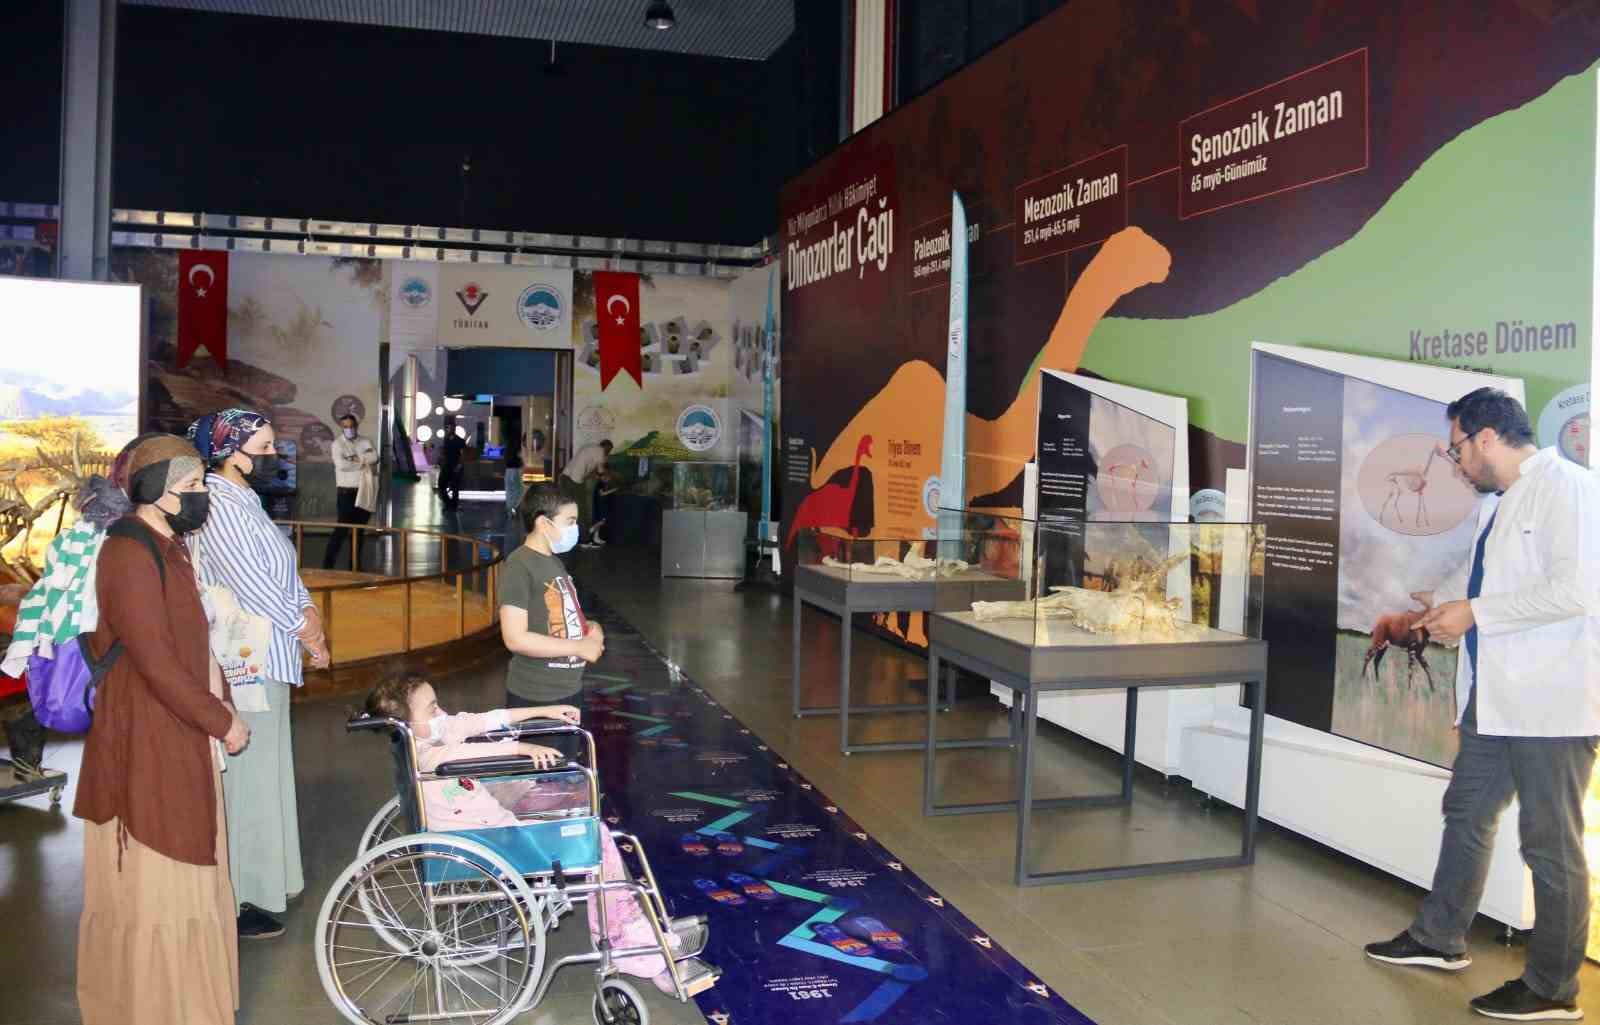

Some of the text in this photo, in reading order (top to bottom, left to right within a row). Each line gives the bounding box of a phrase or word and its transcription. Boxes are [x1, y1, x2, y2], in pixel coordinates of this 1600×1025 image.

[1191, 90, 1343, 167] Senozoik Zaman
[1191, 154, 1268, 193] 65 myö-Günümüz
[1024, 172, 1118, 225] Mezozoik Zaman
[787, 195, 894, 291] Dinozorlar Çağı
[914, 228, 951, 261] Paleozoik
[1408, 320, 1577, 362] Kretase Dönem
